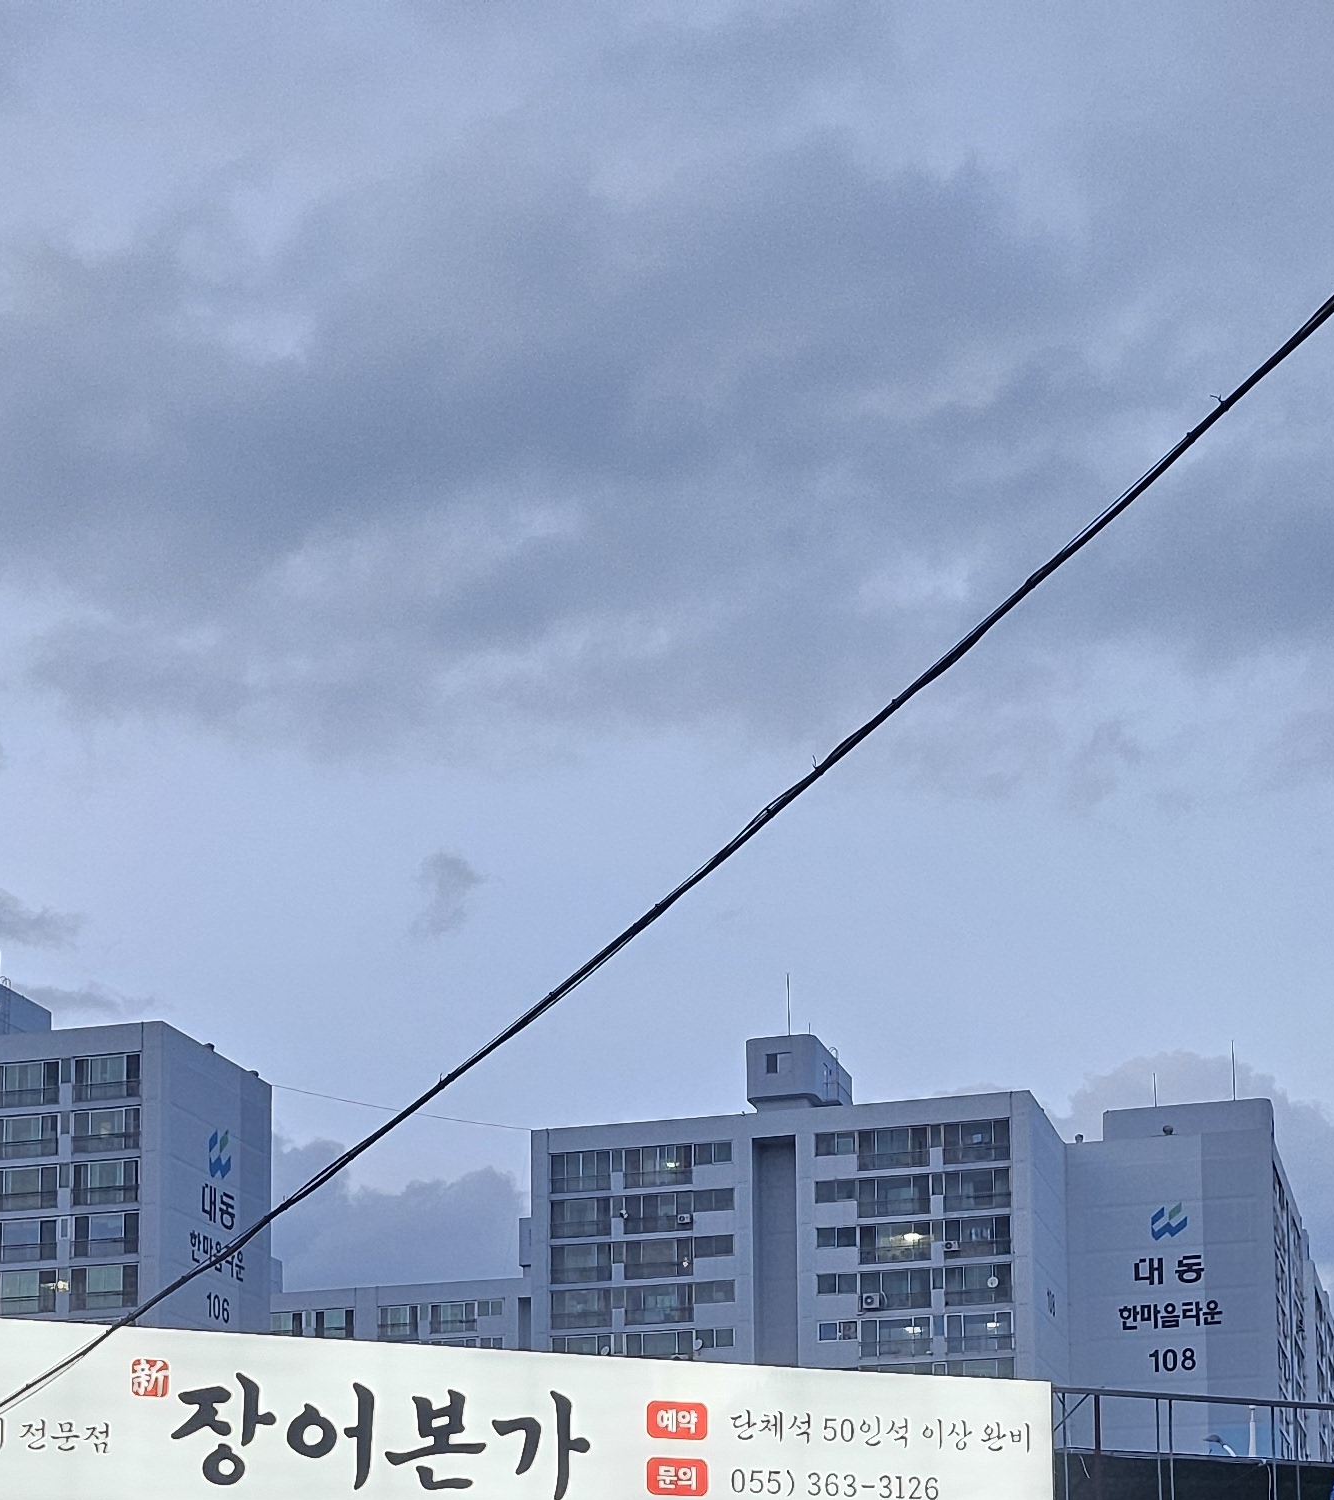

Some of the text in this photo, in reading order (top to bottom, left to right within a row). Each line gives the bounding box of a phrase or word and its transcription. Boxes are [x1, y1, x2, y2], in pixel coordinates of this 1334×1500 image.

[201, 1183, 236, 1231] 대동
[1134, 1254, 1205, 1286] 대동
[206, 1292, 230, 1324] 106
[1119, 1300, 1223, 1331] 한마음타운
[1149, 1347, 1196, 1373] 108
[131, 1359, 169, 1397] 新
[19, 1421, 111, 1454] 전문점
[170, 1372, 591, 1500] 장어본가
[656, 1409, 1031, 1453] 예약 단체석 50인석 이상 완비
[656, 1466, 940, 1500] 문의 055) 363-3126
